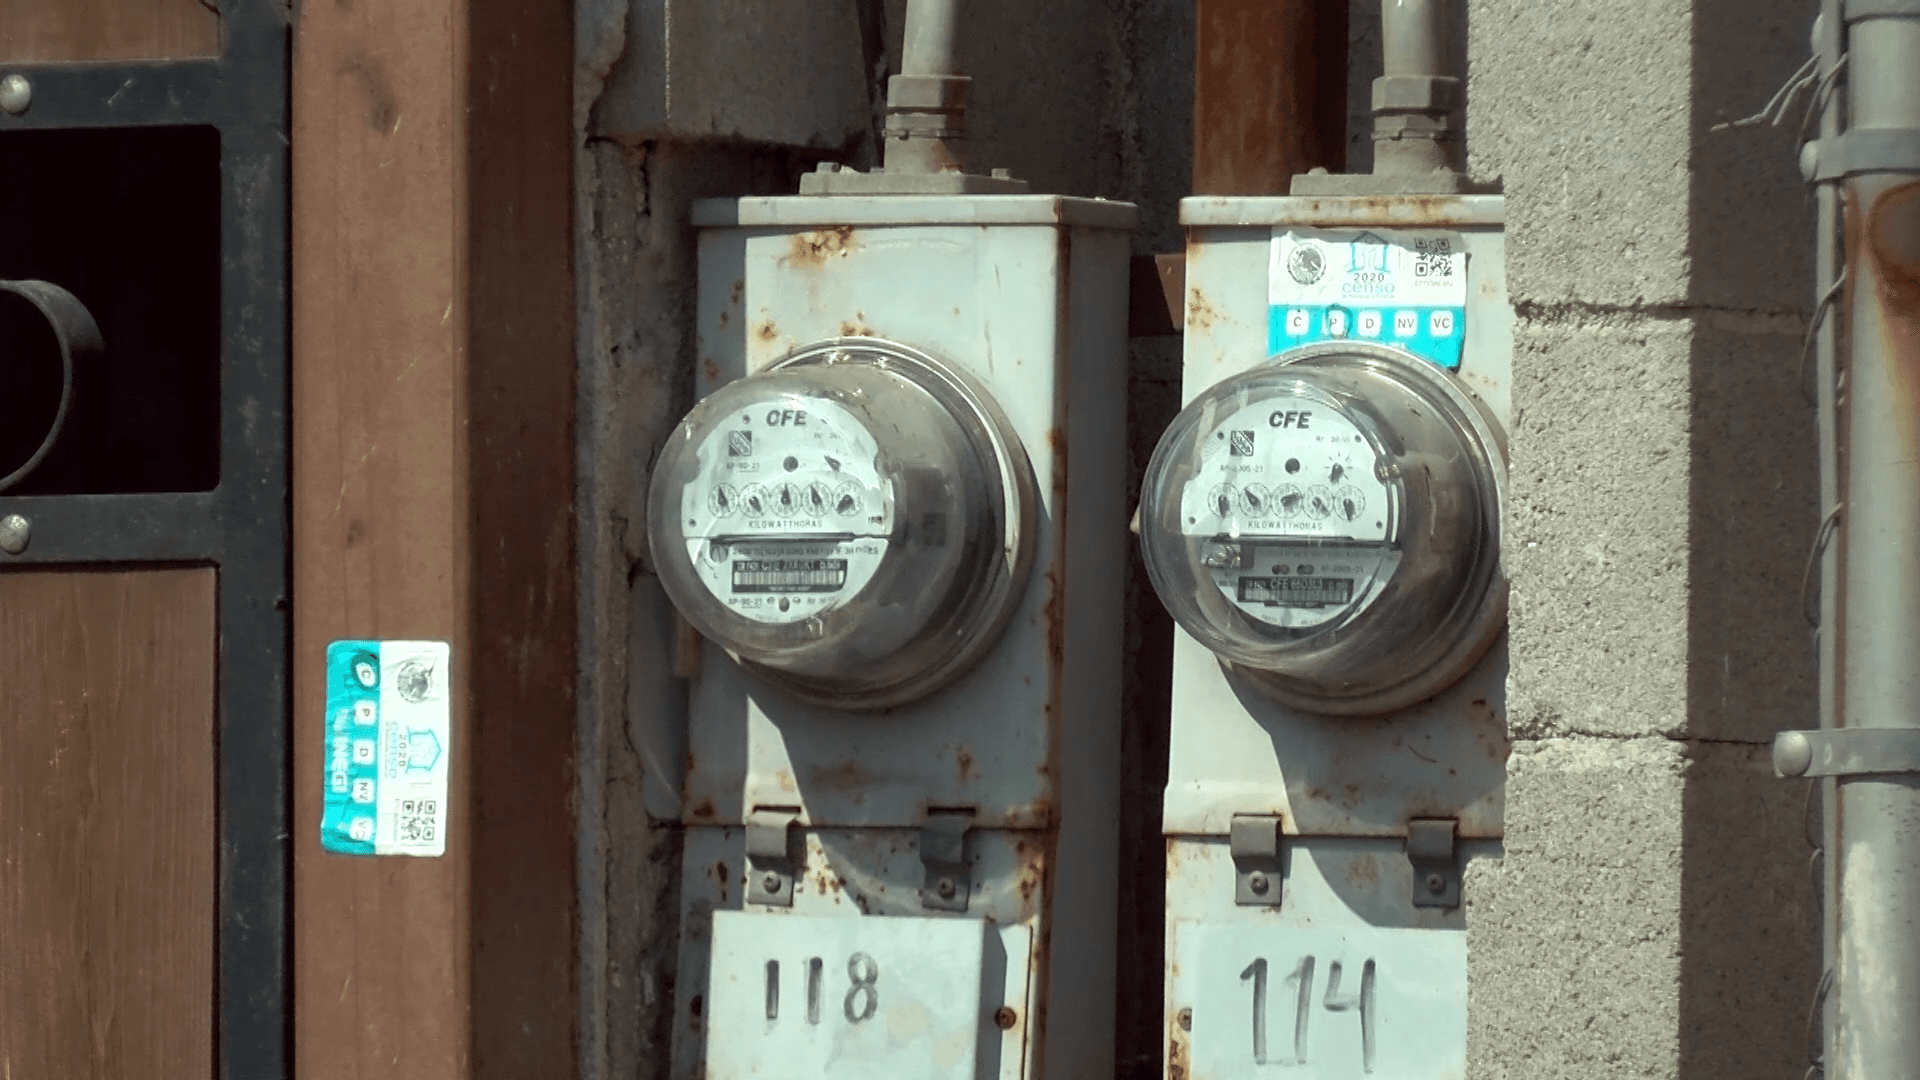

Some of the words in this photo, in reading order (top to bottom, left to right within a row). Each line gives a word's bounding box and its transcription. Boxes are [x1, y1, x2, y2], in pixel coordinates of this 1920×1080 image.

[1354, 273, 1385, 281] 2020
[1342, 282, 1395, 294] censo
[1293, 316, 1302, 328] C
[1330, 318, 1337, 328] P
[1365, 318, 1374, 329] D
[1398, 318, 1415, 329] NV
[1434, 318, 1450, 329] VC
[766, 409, 808, 427] CFE
[1269, 410, 1312, 429] CFE
[748, 520, 822, 529] KILOWATTHORAS
[1247, 521, 1323, 531] KILOWATTHORAS
[361, 668, 371, 679] C
[361, 707, 371, 717] P
[359, 748, 369, 757] D
[399, 734, 407, 767] 2020
[359, 781, 368, 801] NV
[356, 821, 367, 839] VC
[766, 953, 878, 1024] 118
[1240, 956, 1377, 1073] 114
